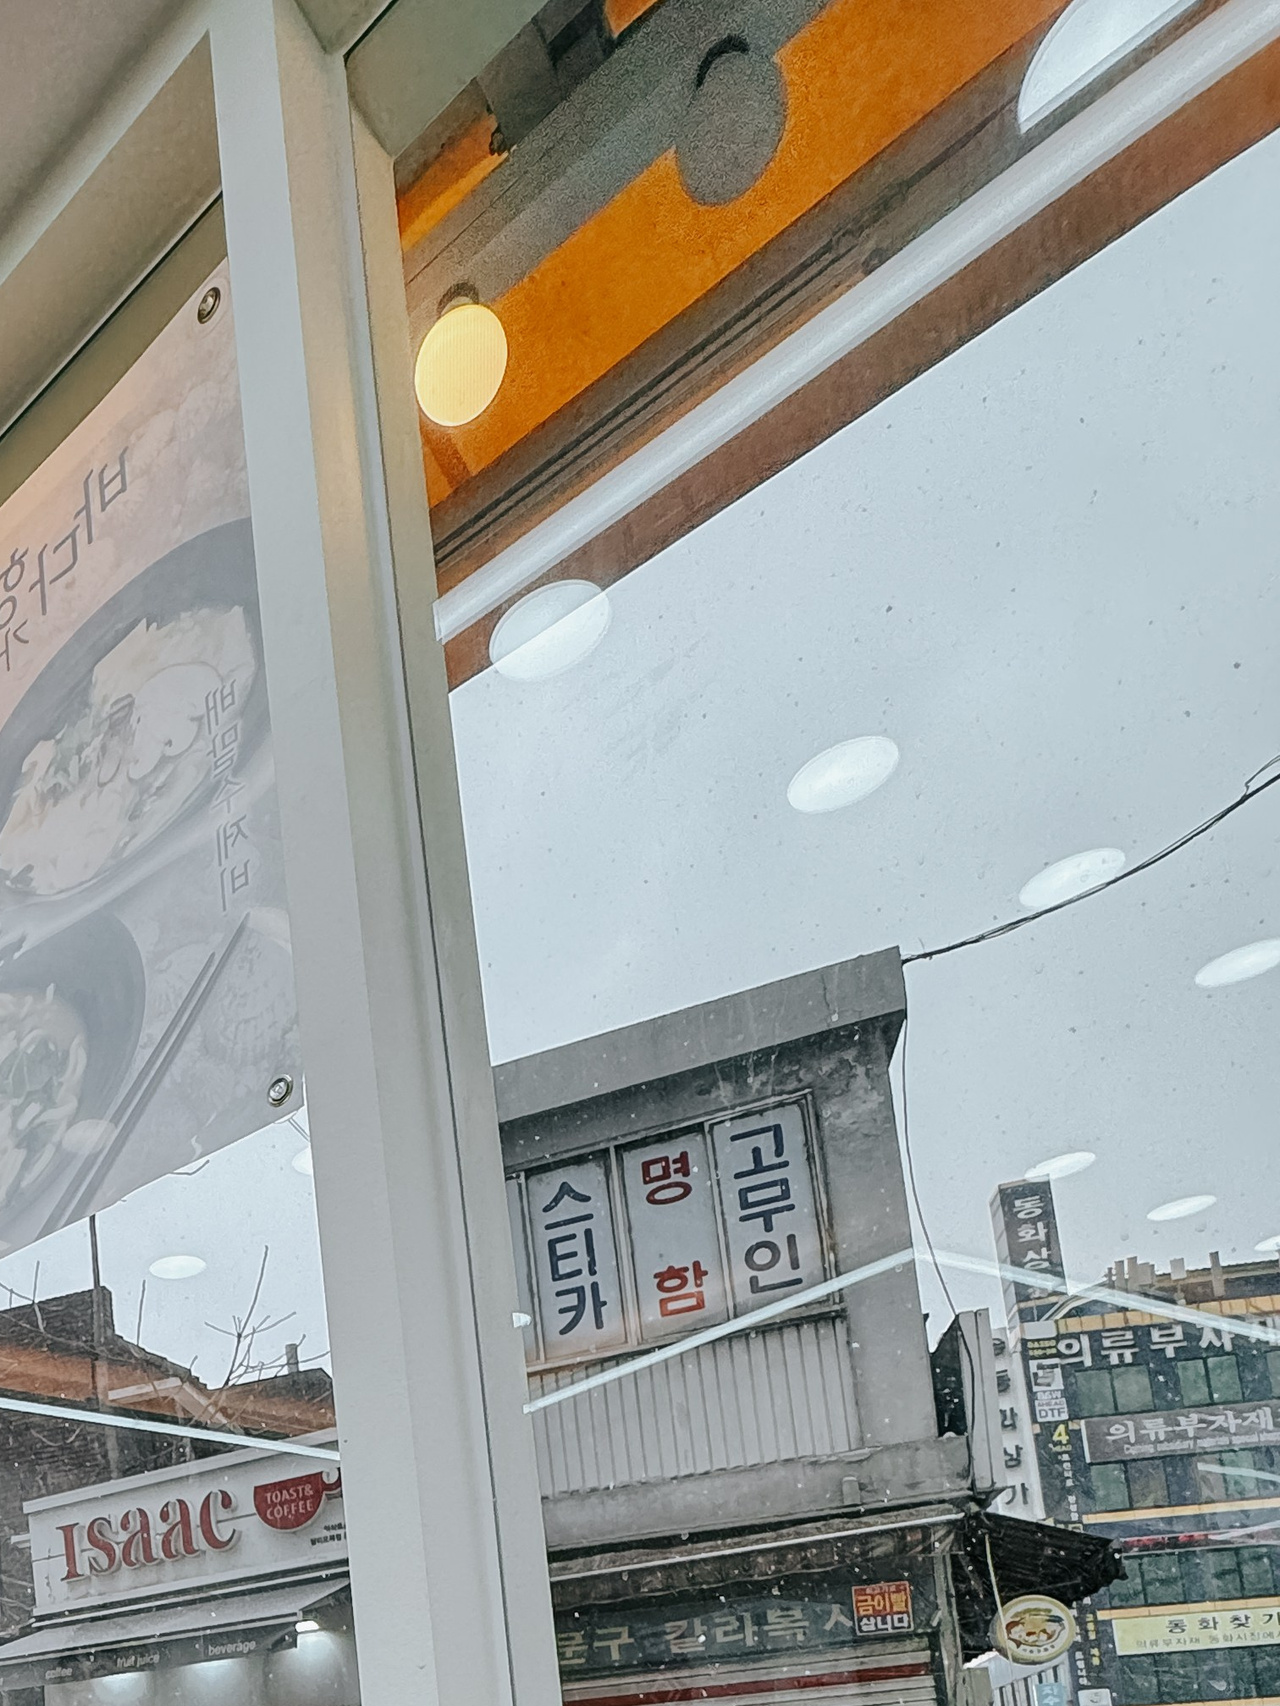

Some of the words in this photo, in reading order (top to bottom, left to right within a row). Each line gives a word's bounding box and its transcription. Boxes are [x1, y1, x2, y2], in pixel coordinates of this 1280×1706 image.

[729, 1121, 804, 1295] 고무인
[540, 1180, 610, 1338] 스티카
[1106, 1407, 1274, 1443] 의류부자재
[265, 1499, 314, 1521] COFFEE
[855, 1591, 909, 1615] 금이빨
[860, 1613, 909, 1632] 삽니다
[207, 1639, 257, 1656] beverage
[137, 1652, 160, 1668] juice
[45, 1667, 72, 1680] coffee
